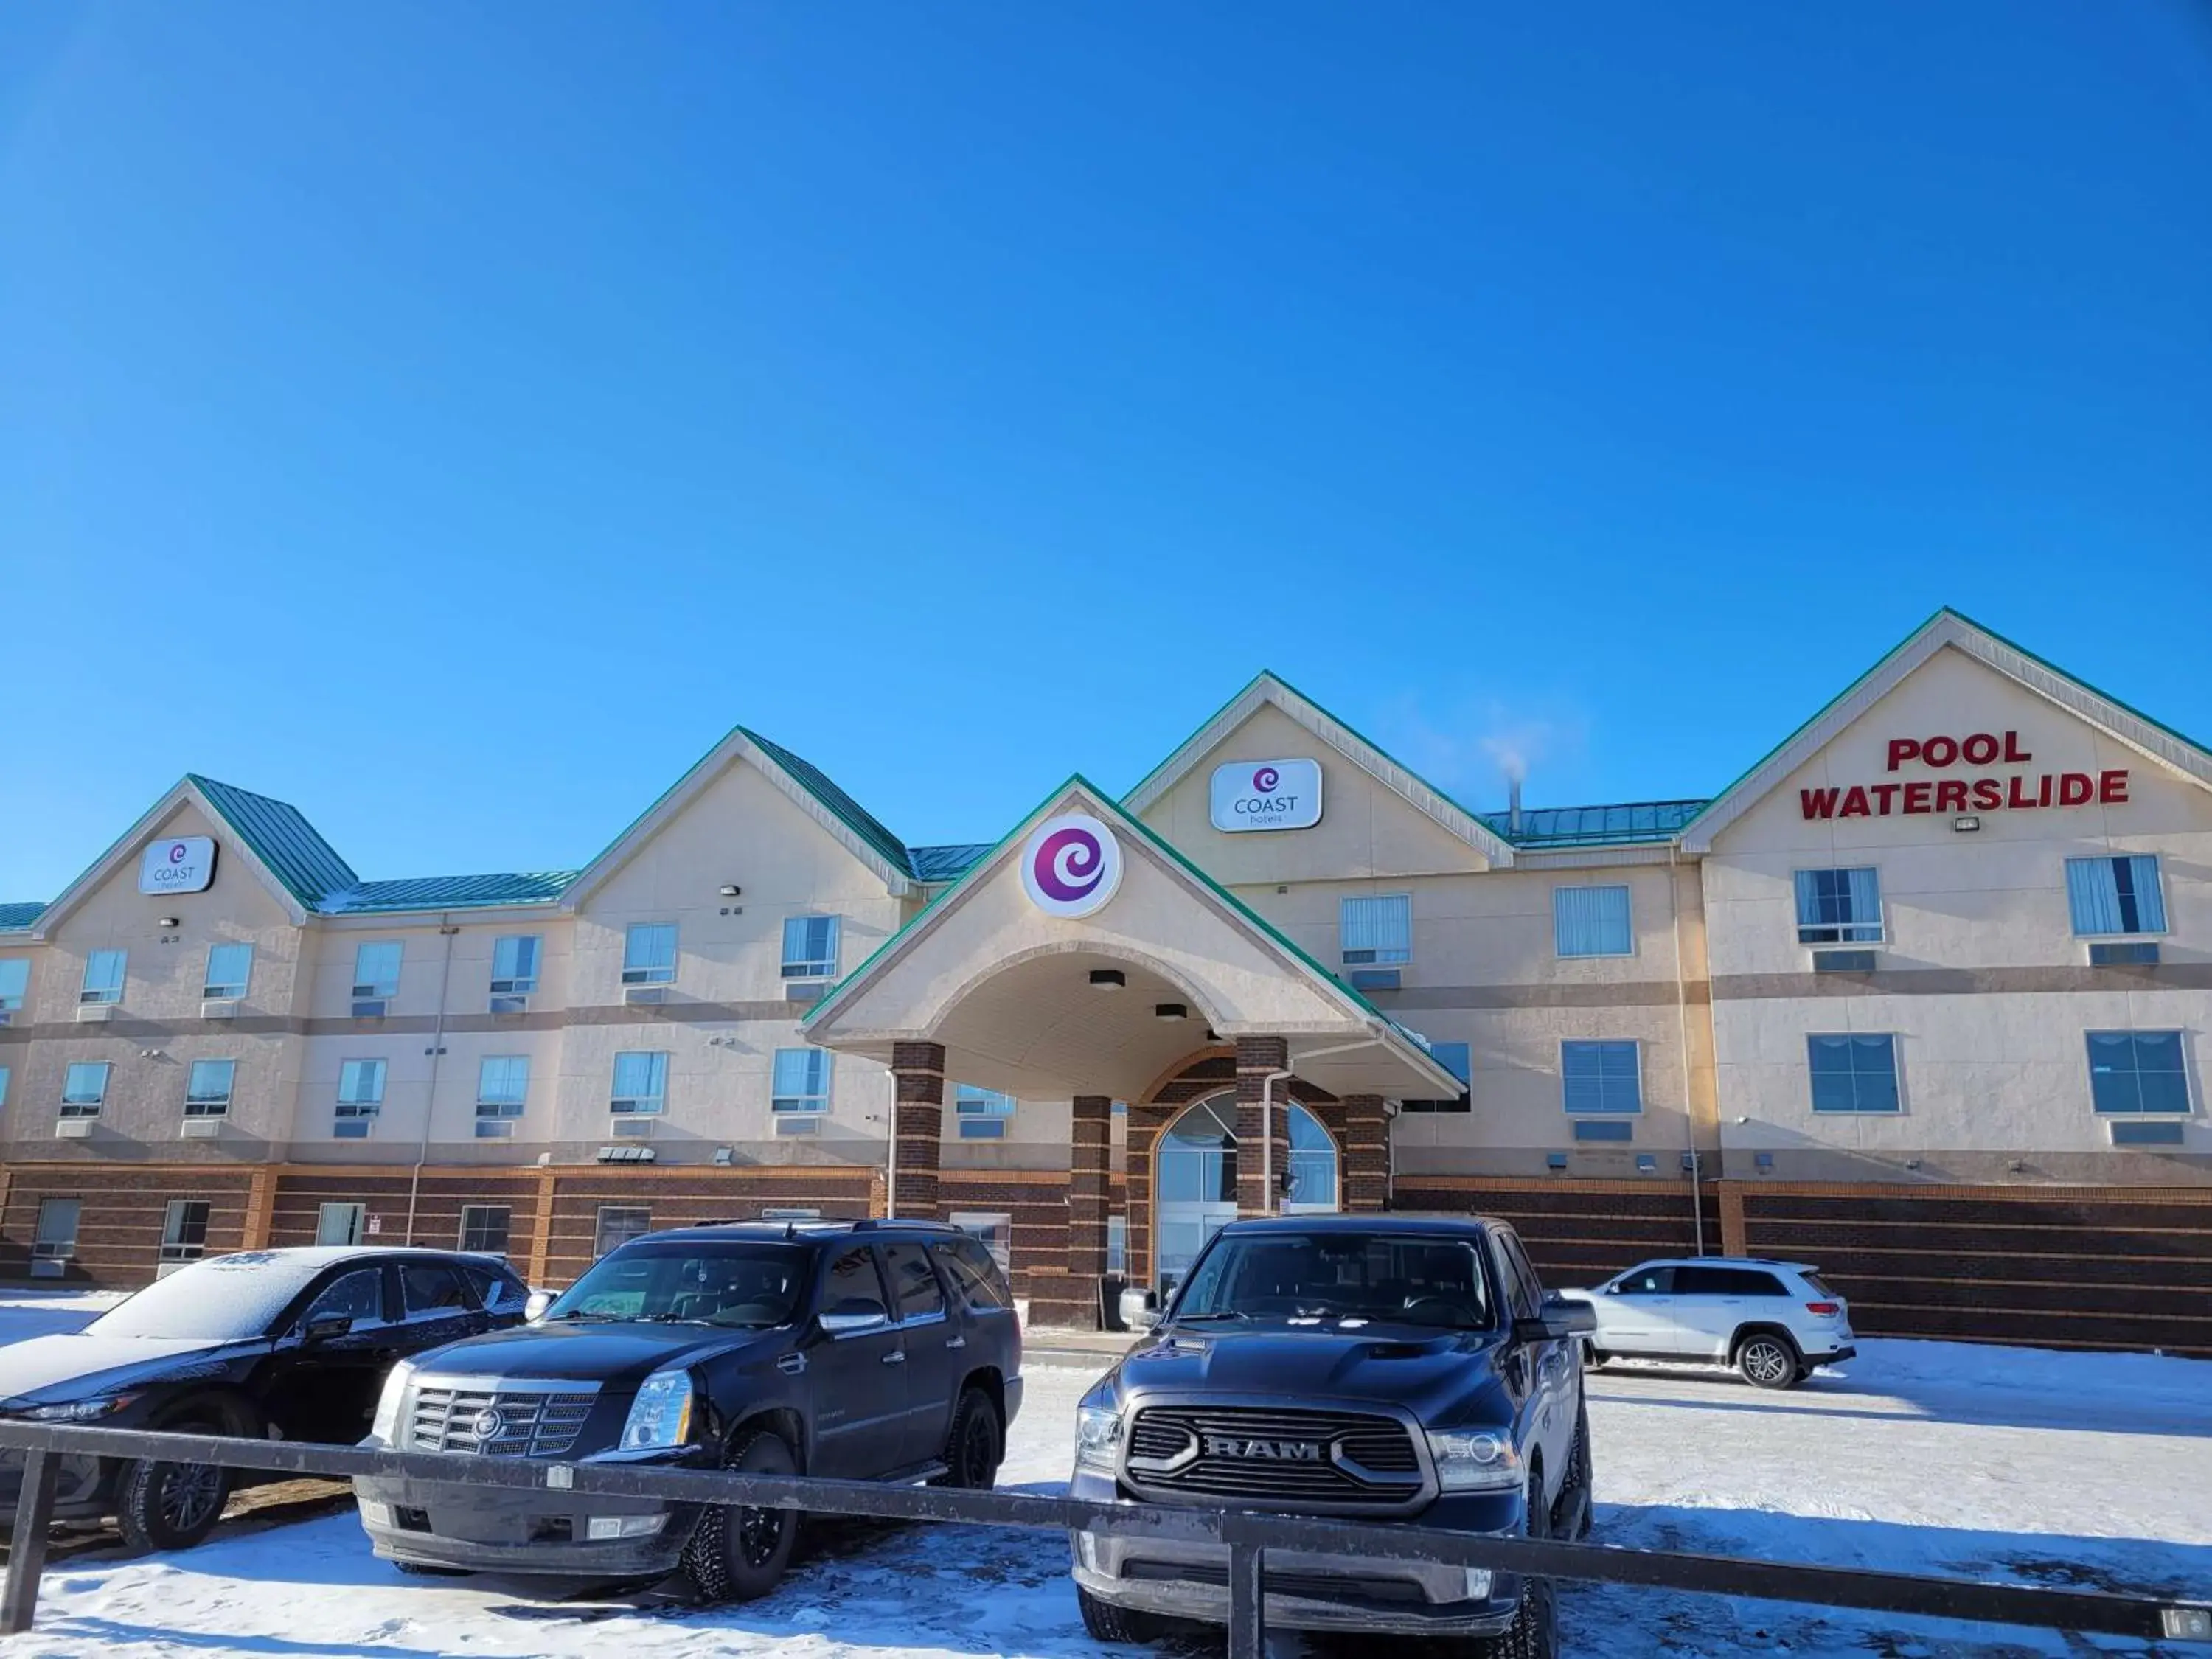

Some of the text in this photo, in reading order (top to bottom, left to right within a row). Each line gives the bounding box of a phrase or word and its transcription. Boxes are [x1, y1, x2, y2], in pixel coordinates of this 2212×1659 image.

[1887, 731, 2032, 771] POOL
[1234, 796, 1298, 814] COAST
[1800, 769, 2129, 820] WATERSLIDE
[1250, 814, 1283, 824] hotels
[154, 866, 195, 881] COAST
[1207, 1436, 1321, 1460] RAM
